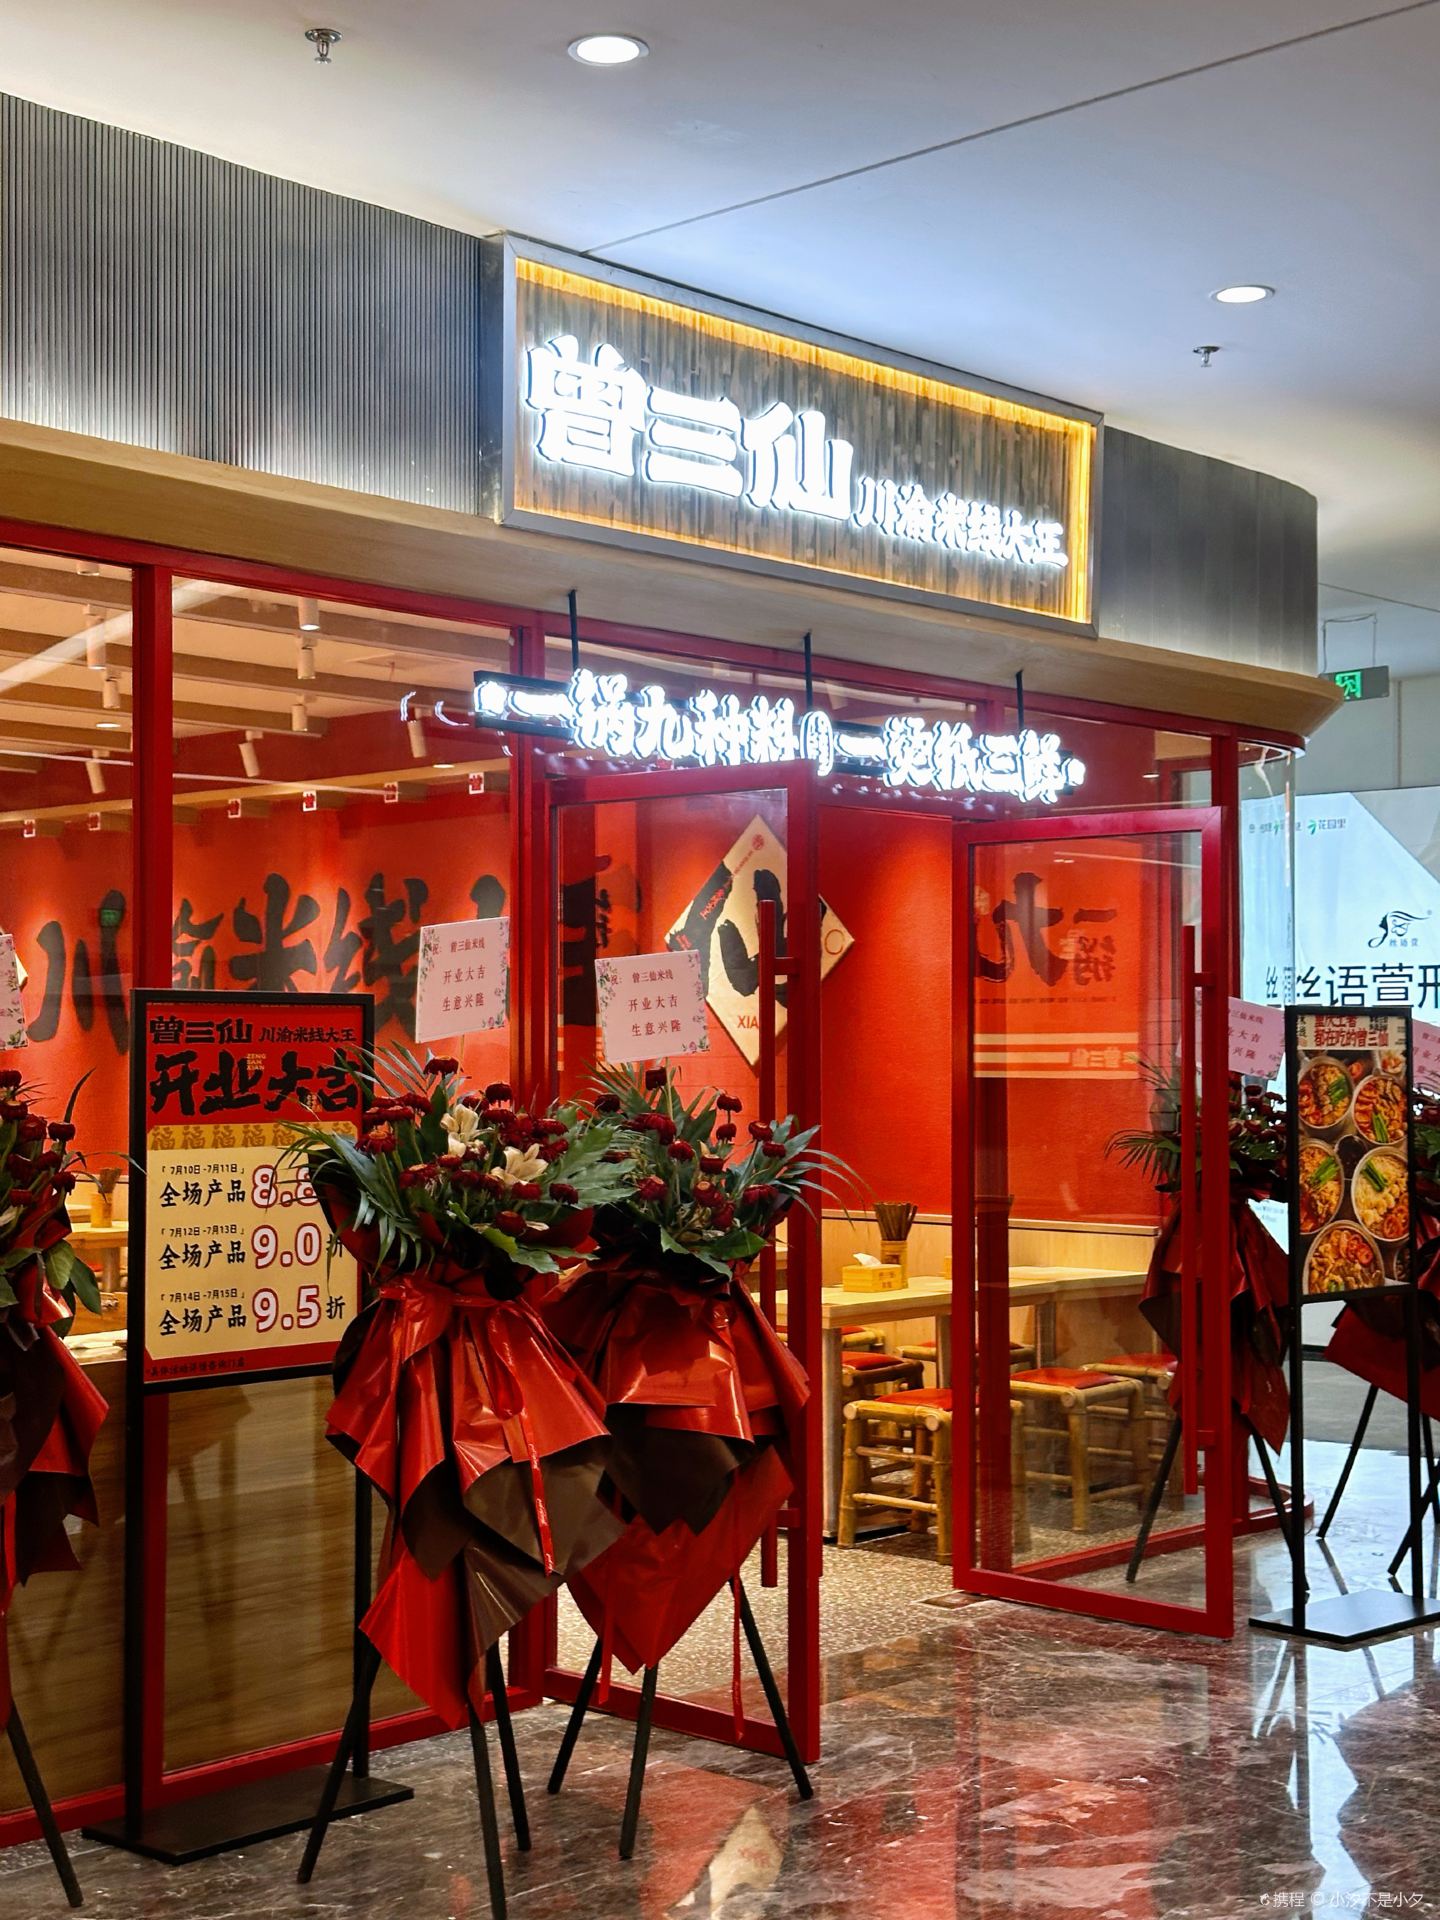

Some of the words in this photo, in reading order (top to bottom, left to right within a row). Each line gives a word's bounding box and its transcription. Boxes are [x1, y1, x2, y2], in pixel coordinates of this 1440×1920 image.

[525, 335, 854, 520] 曾三仙
[853, 476, 1069, 568] 川渝米线大王
[443, 964, 486, 985] 开业大吉
[442, 991, 485, 1013] 生意兴隆
[628, 993, 678, 1013] 开业大吉
[150, 1015, 253, 1045] 曾三仙
[259, 1026, 357, 1044] 川渝米线大王
[631, 1018, 682, 1038] 生意兴隆
[737, 1015, 760, 1029] XIA
[150, 1048, 360, 1117] 开业大吉
[160, 1179, 246, 1208] 全场产品
[159, 1240, 246, 1270] 全场产品
[251, 1222, 322, 1270] 9.0
[159, 1304, 247, 1337] 全场产品
[252, 1285, 322, 1334] 9.5
[325, 1295, 346, 1320] 折
